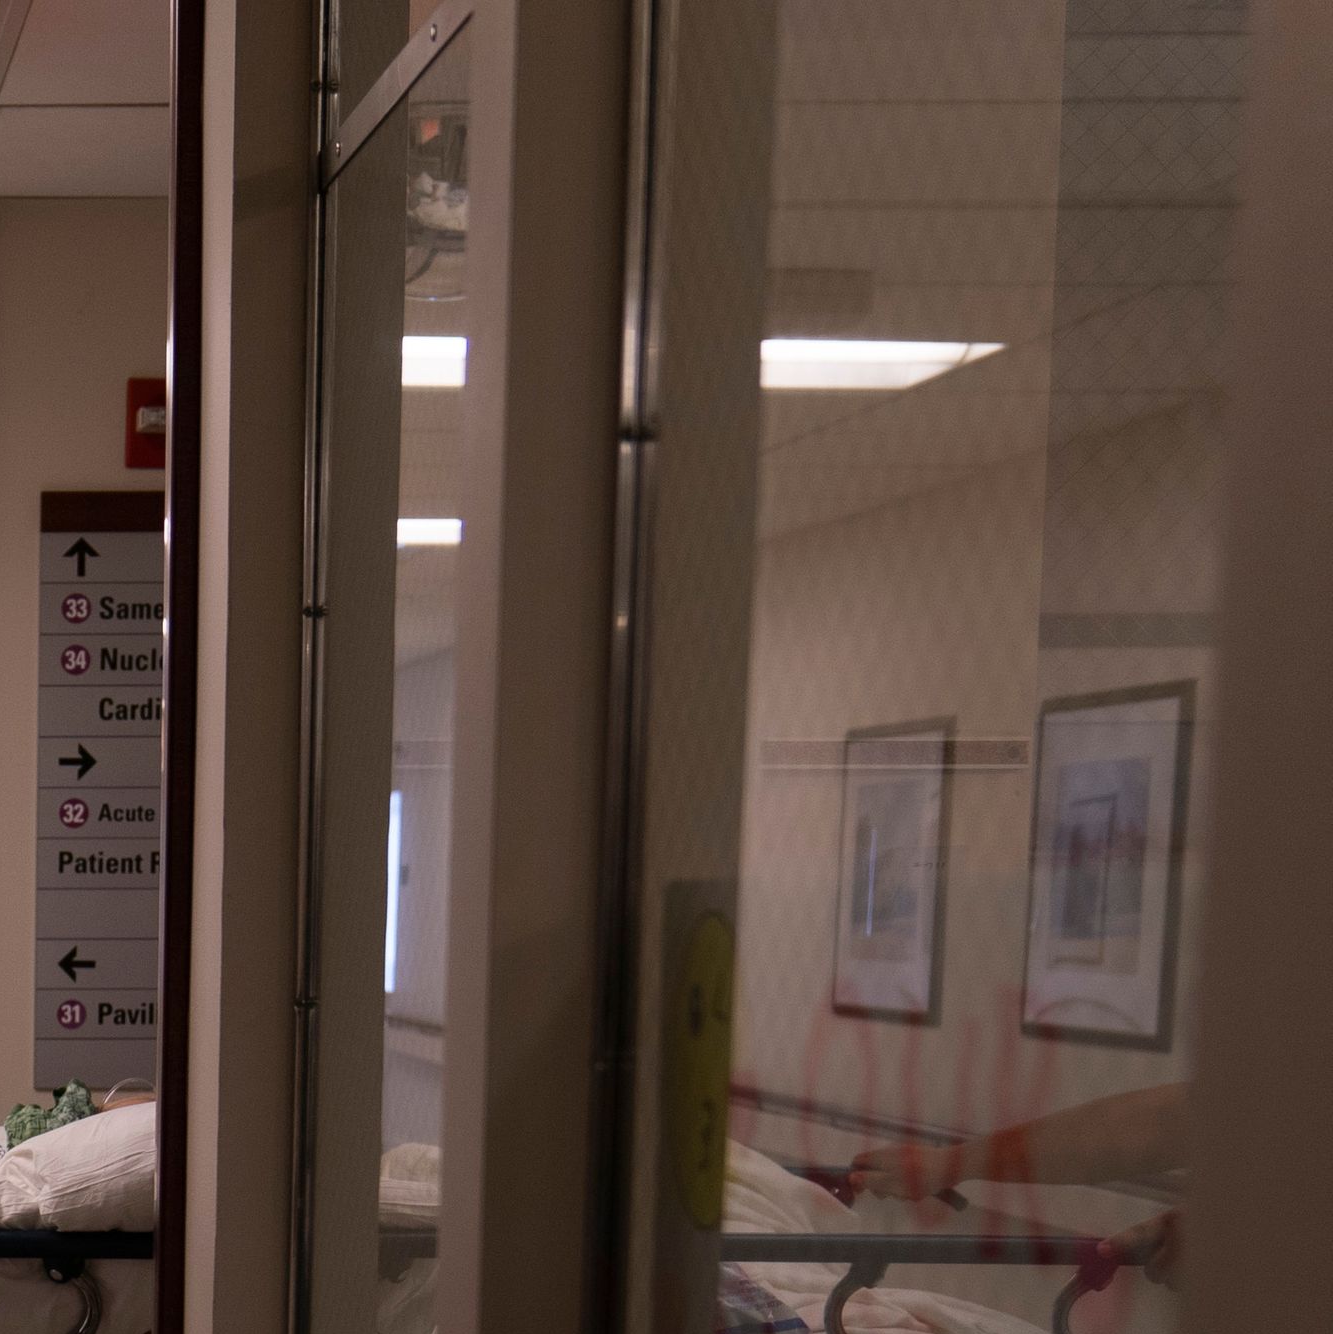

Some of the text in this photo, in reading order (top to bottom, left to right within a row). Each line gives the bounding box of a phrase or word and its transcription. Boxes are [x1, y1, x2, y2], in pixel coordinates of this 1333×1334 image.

[65, 596, 163, 620] 33 Same
[64, 647, 163, 672] 34 Nucl
[62, 803, 156, 824] 32 Acute
[58, 851, 143, 874] Patient
[60, 1002, 154, 1025] 31 Pavil
